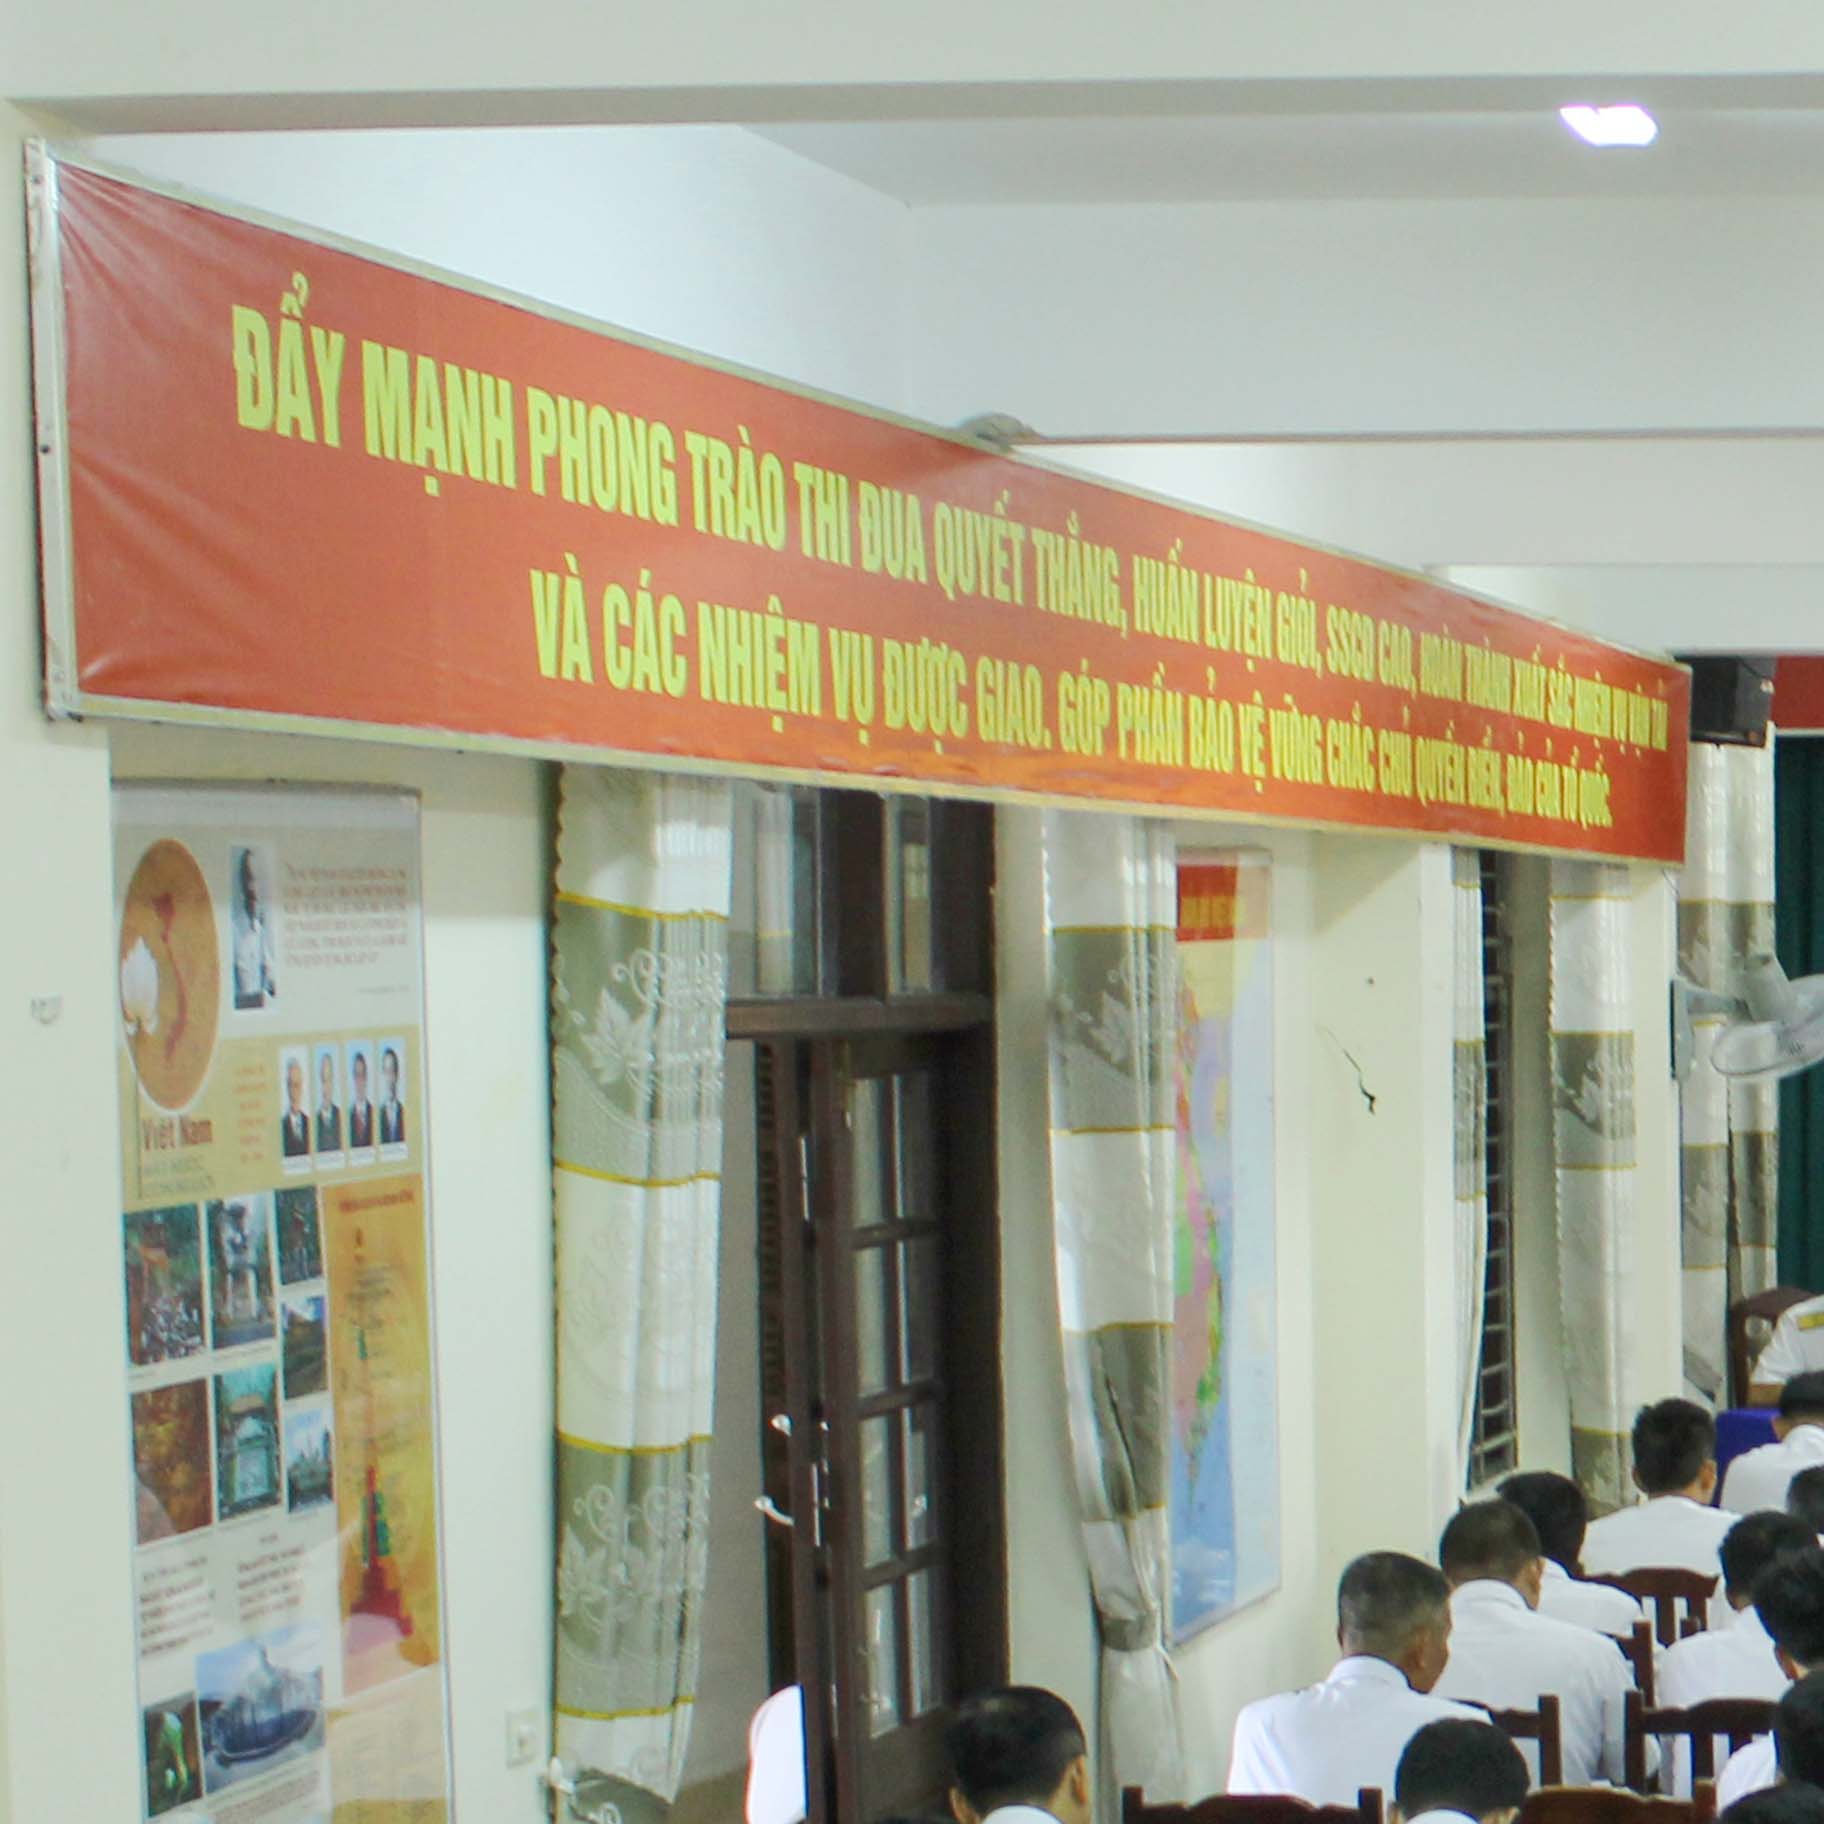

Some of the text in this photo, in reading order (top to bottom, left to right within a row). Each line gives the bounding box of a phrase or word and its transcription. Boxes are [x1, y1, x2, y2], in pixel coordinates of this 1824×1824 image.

[231, 273, 345, 448] ĐẨY
[362, 341, 516, 497] MẠNH
[527, 387, 677, 527] PHONG
[686, 427, 786, 551] TRÀO
[793, 461, 852, 568] THI
[859, 480, 928, 584] ĐUA
[934, 489, 1026, 606] QUYẾT
[1031, 510, 1128, 639] THẮNG,
[1133, 538, 1200, 645] HUẤN
[1204, 568, 1273, 672] LUYỆN
[1276, 568, 1324, 679] GIỎI,
[1378, 618, 1417, 699] CAO,
[529, 552, 594, 683] VÀ
[603, 569, 687, 698] CÁC
[698, 594, 821, 733] NHIỆM
[828, 627, 874, 746] VỤ
[882, 636, 968, 755] ĐƯỢC
[1057, 657, 1111, 757] GÓP
[1117, 661, 1184, 767] PHẦN
[1189, 666, 1234, 774] BẢO
[1238, 690, 1266, 793] VỆ
[1269, 693, 1324, 784] VỮNG
[1326, 700, 1376, 793] CHẮC
[1378, 704, 1412, 798] CHỦ
